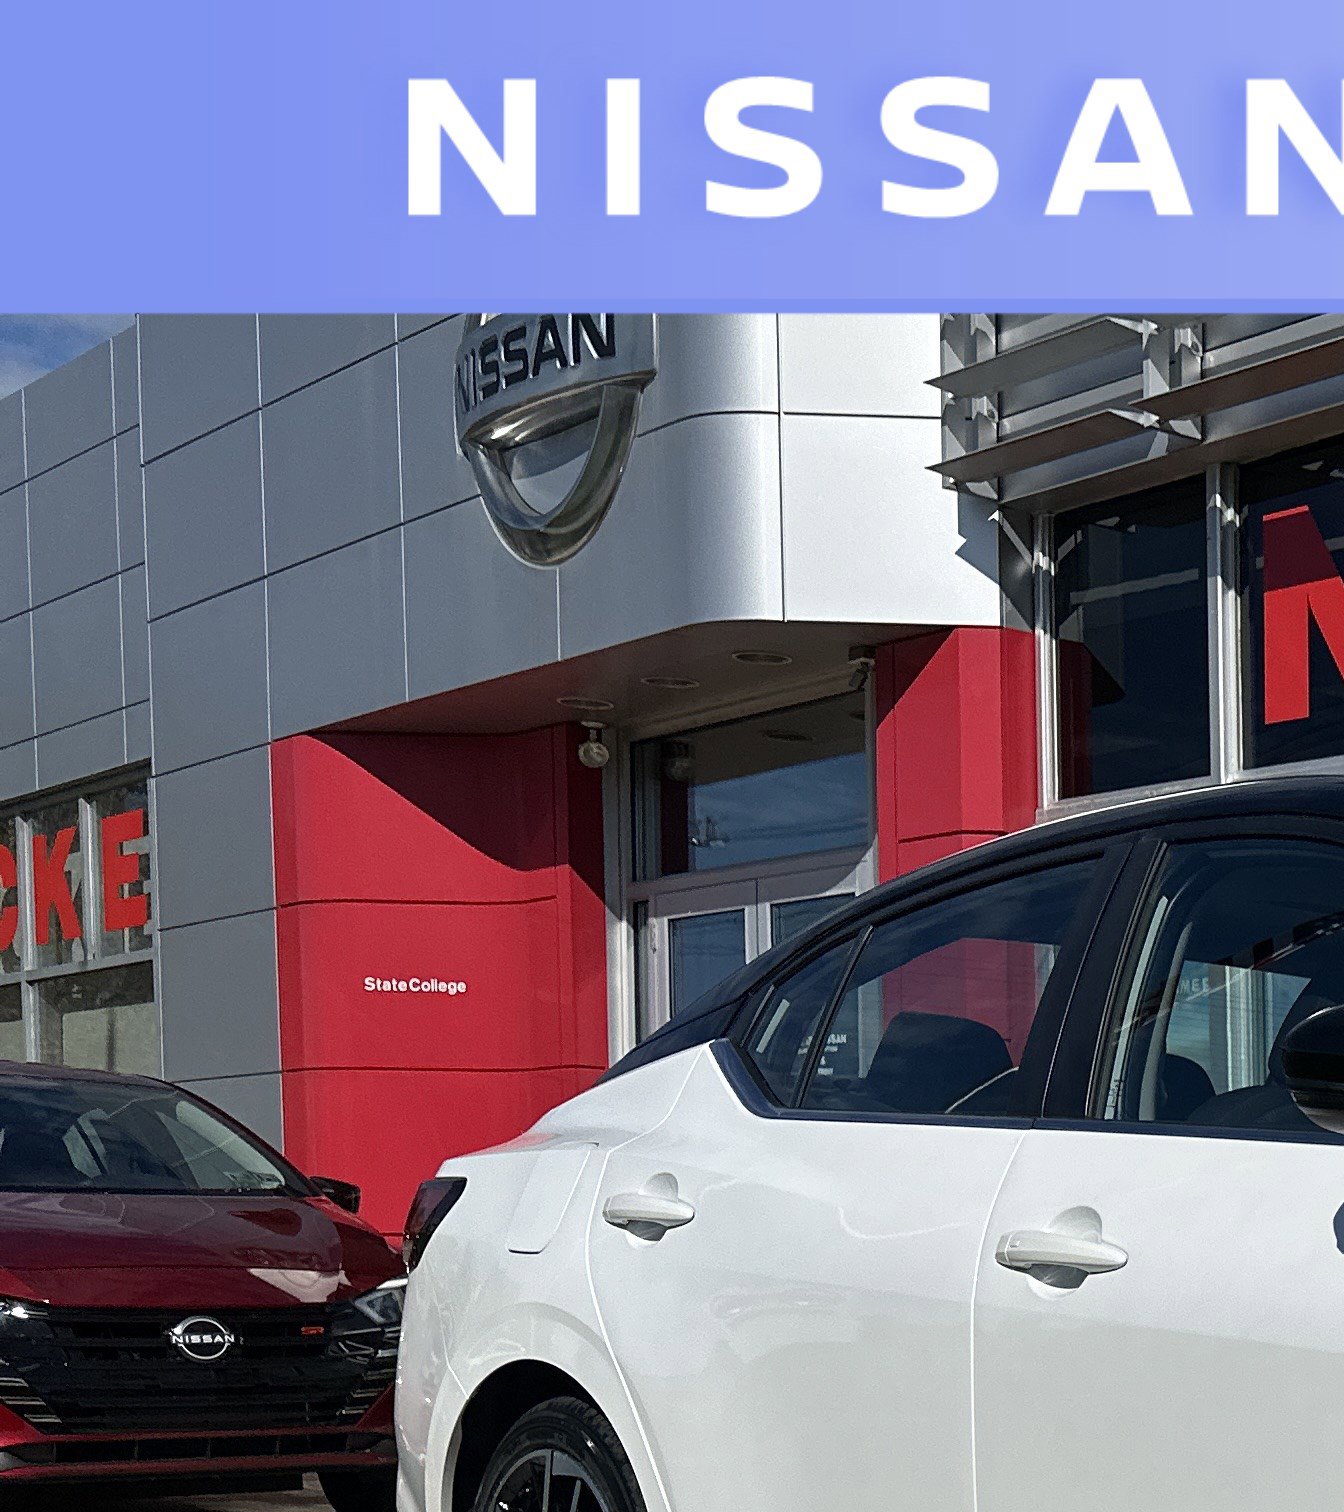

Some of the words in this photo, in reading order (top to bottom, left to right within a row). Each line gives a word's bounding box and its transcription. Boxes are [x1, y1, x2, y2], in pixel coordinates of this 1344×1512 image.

[454, 313, 616, 413] NISSAN
[363, 976, 408, 992] State
[408, 977, 467, 996] College
[172, 1334, 235, 1344] NISSAN
